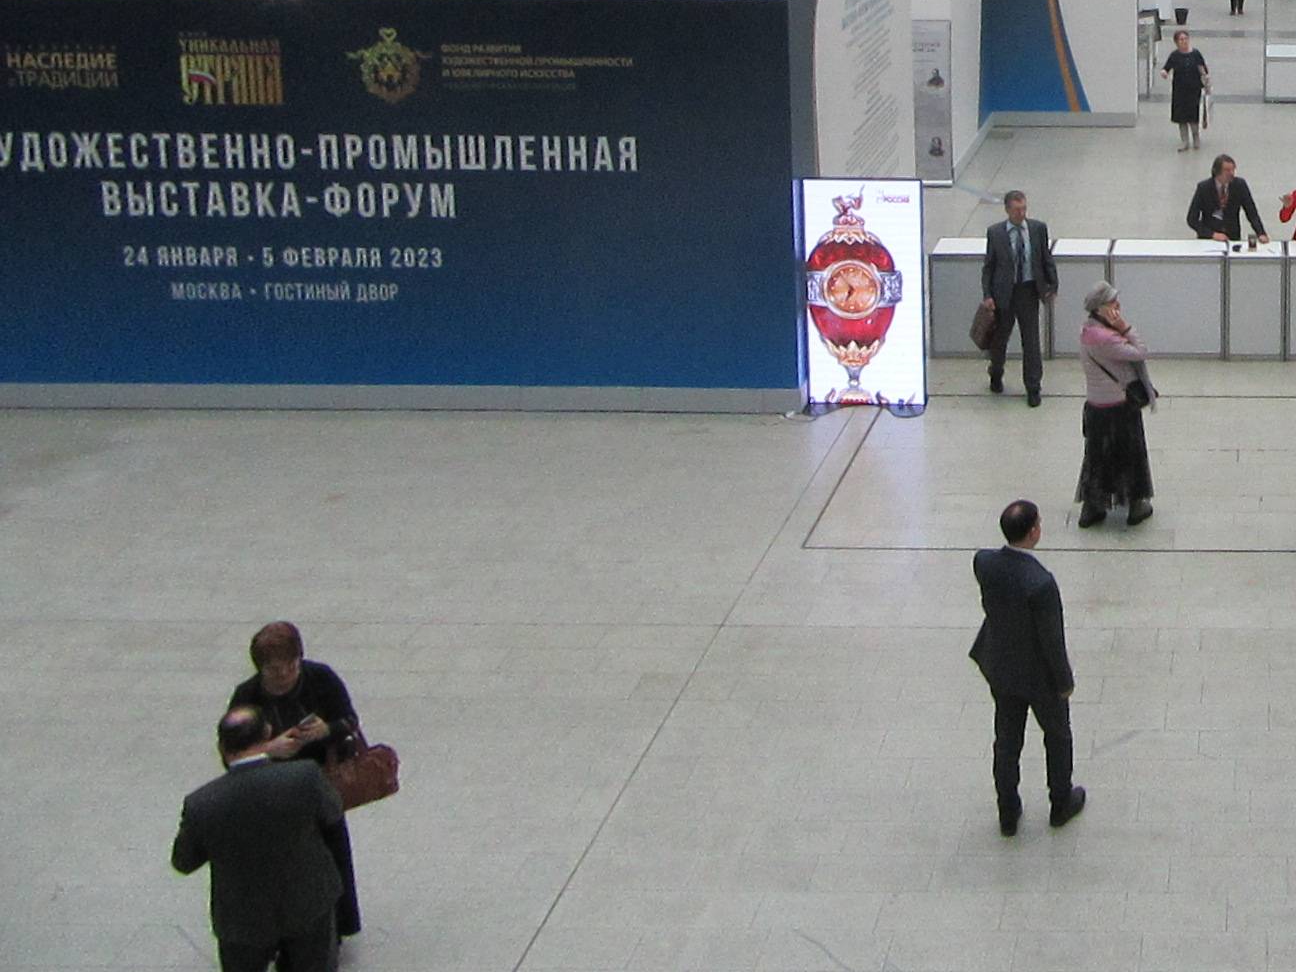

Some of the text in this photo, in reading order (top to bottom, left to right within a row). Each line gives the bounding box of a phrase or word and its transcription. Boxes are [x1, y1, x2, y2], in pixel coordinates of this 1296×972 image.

[6, 51, 118, 70] НАСЛЕДИЕ
[17, 70, 119, 90] ТРАДИЦИИ
[0, 132, 638, 172] УДОЖЕСТВЕННО-ПРОМЫШЛЕННАЯ
[101, 180, 456, 218] ВЫСТАВКА-ФОРУМ
[123, 245, 149, 267] 24
[157, 245, 239, 267] ЯНВАРЯ
[262, 247, 274, 268] 5
[283, 246, 382, 268] ФЕВРАЛЯ
[390, 247, 443, 268] 2023
[171, 281, 399, 303] МОСКВА ГОСТИНЫЙ ДВОР
